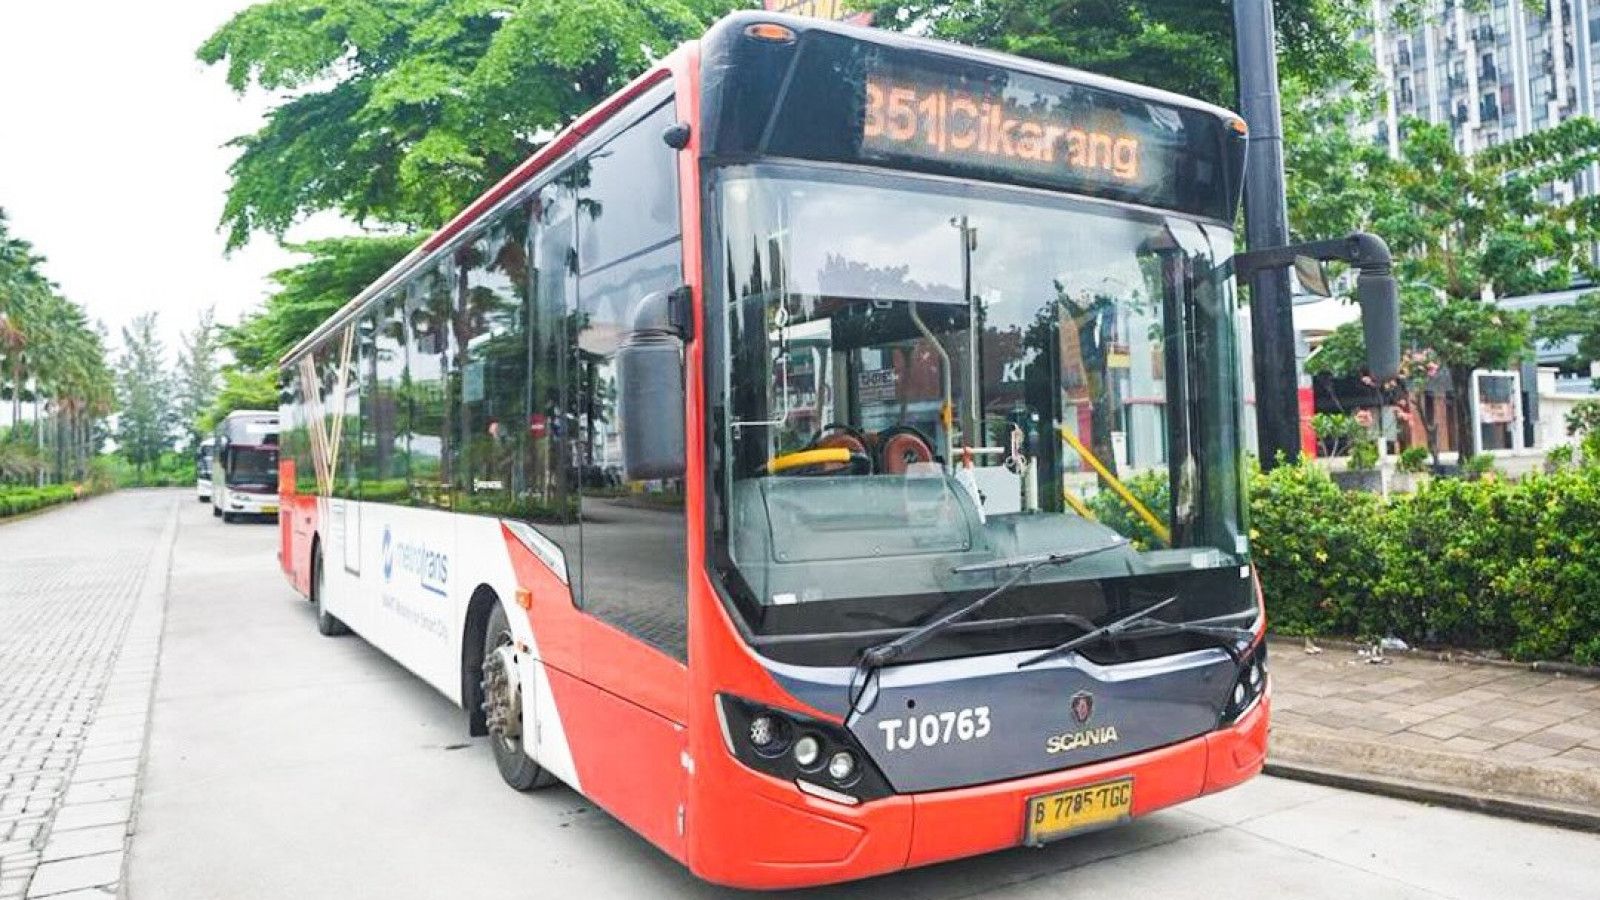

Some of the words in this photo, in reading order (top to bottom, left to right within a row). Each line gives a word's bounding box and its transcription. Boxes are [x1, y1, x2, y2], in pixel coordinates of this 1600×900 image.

[878, 706, 991, 751] TJ0763
[1046, 726, 1118, 753] SCANIA
[1035, 801, 1045, 824] B
[1096, 784, 1130, 809] TGC
